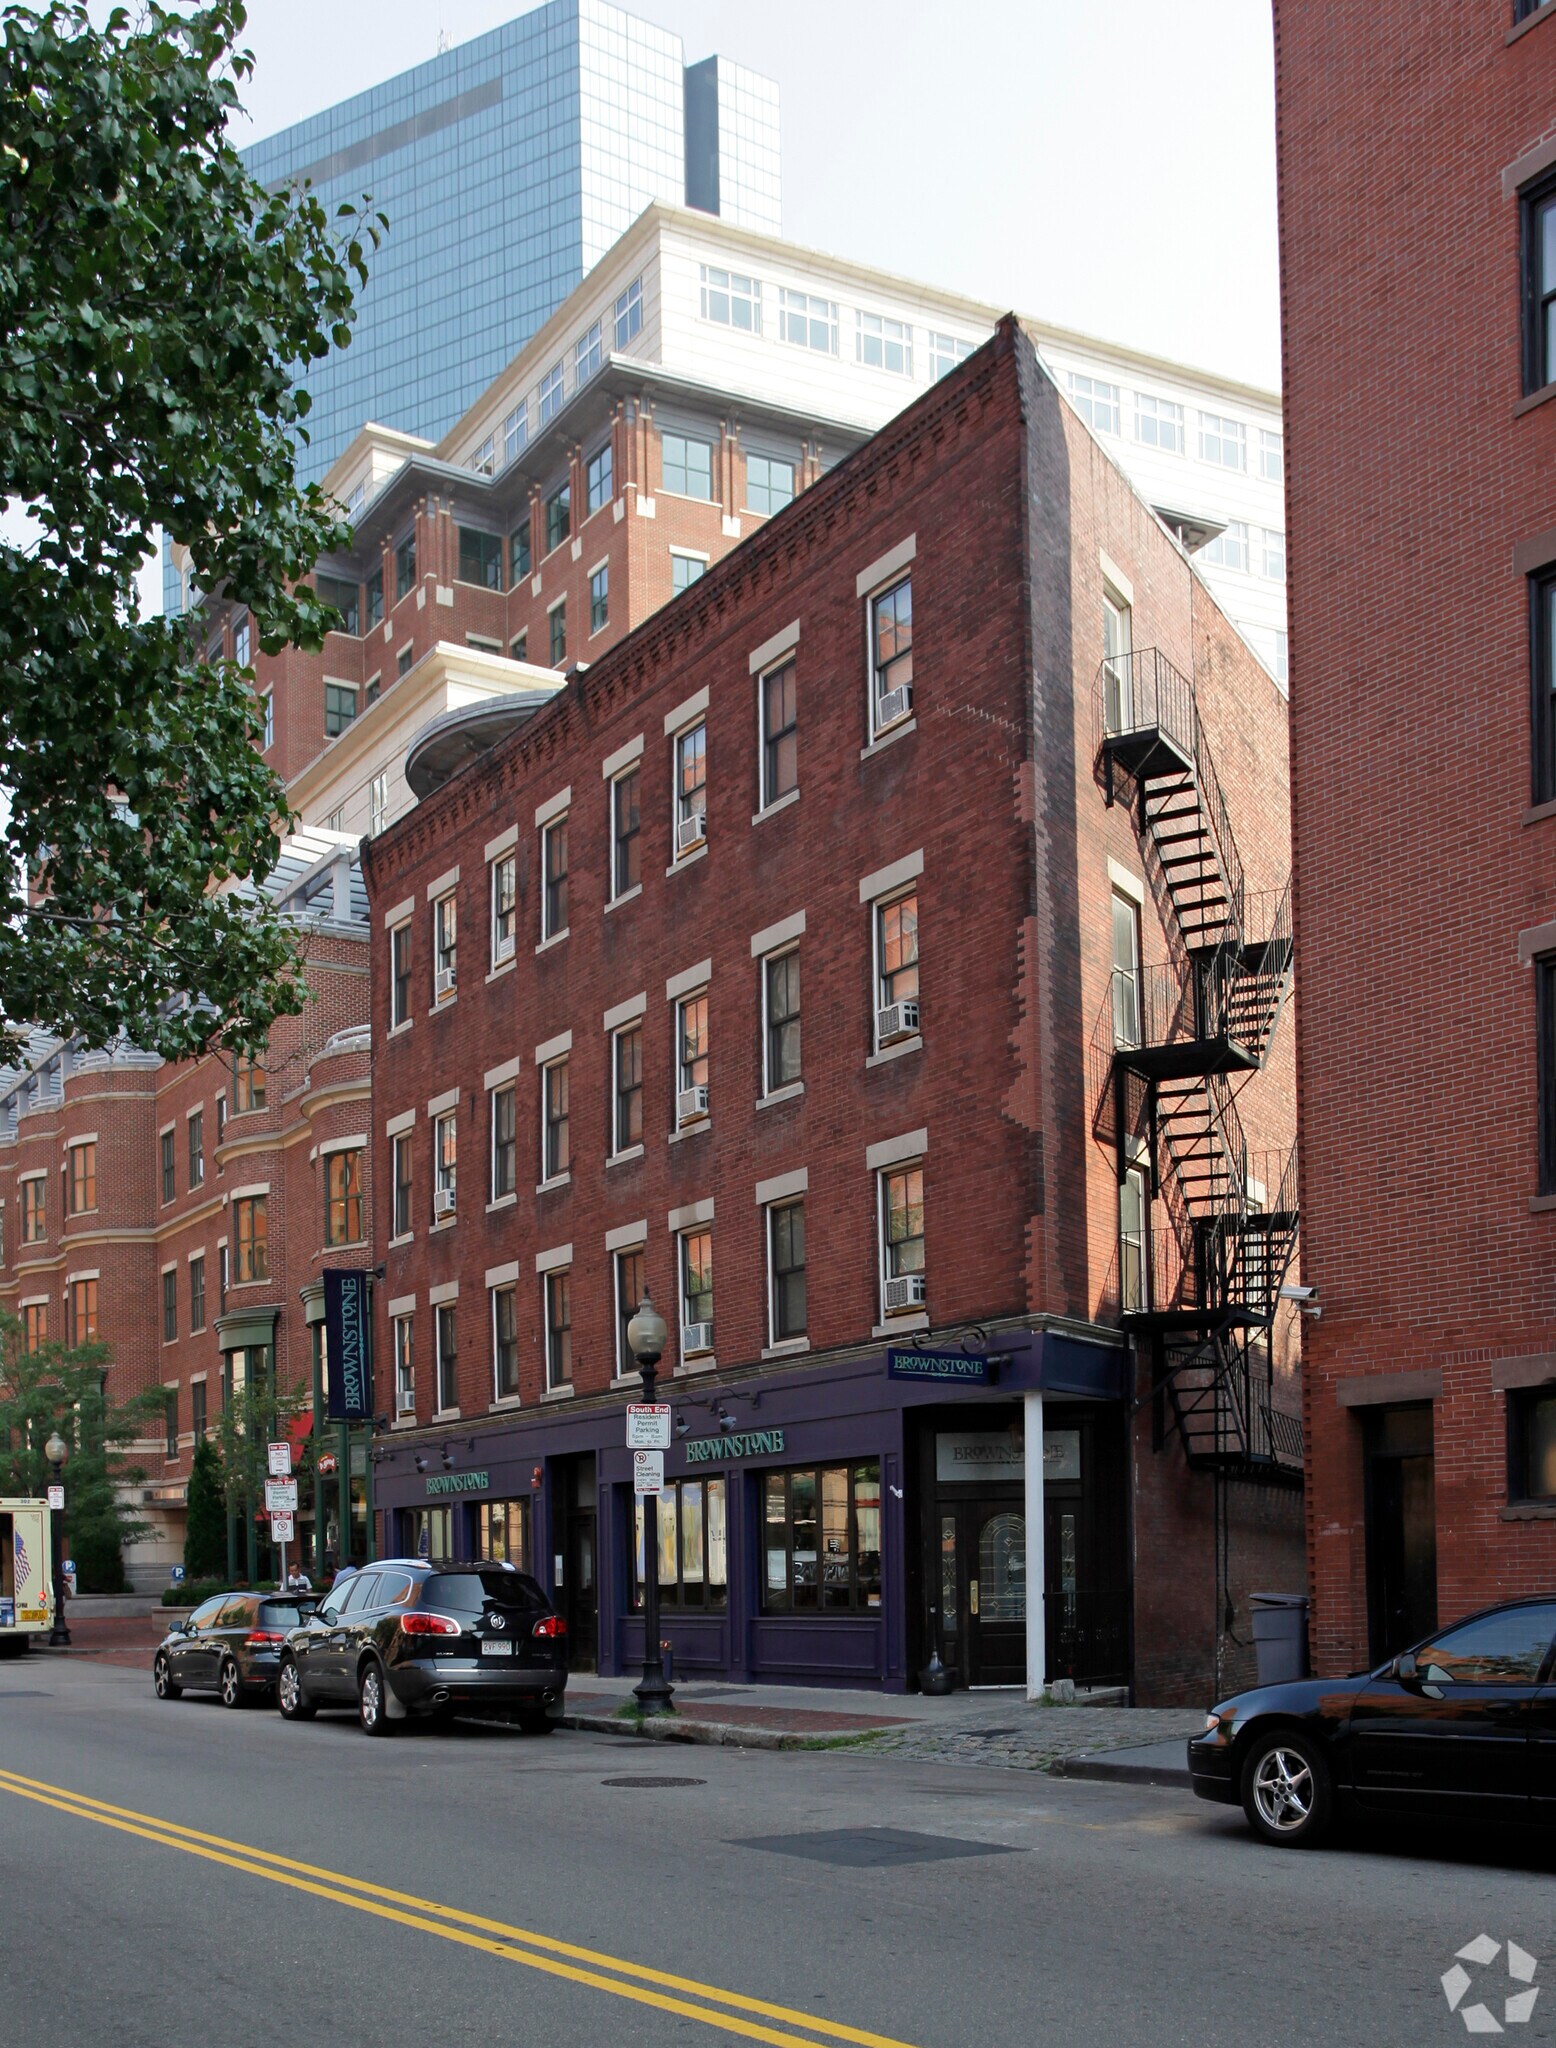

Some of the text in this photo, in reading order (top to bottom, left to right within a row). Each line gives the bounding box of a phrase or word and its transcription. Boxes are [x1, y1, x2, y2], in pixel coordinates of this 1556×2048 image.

[342, 1278, 360, 1410] BROWNSTONE
[893, 1355, 983, 1374] BROWNSTONE
[685, 1430, 784, 1463] BROWNSTONE
[425, 1471, 488, 1495] BROWNSTONE
